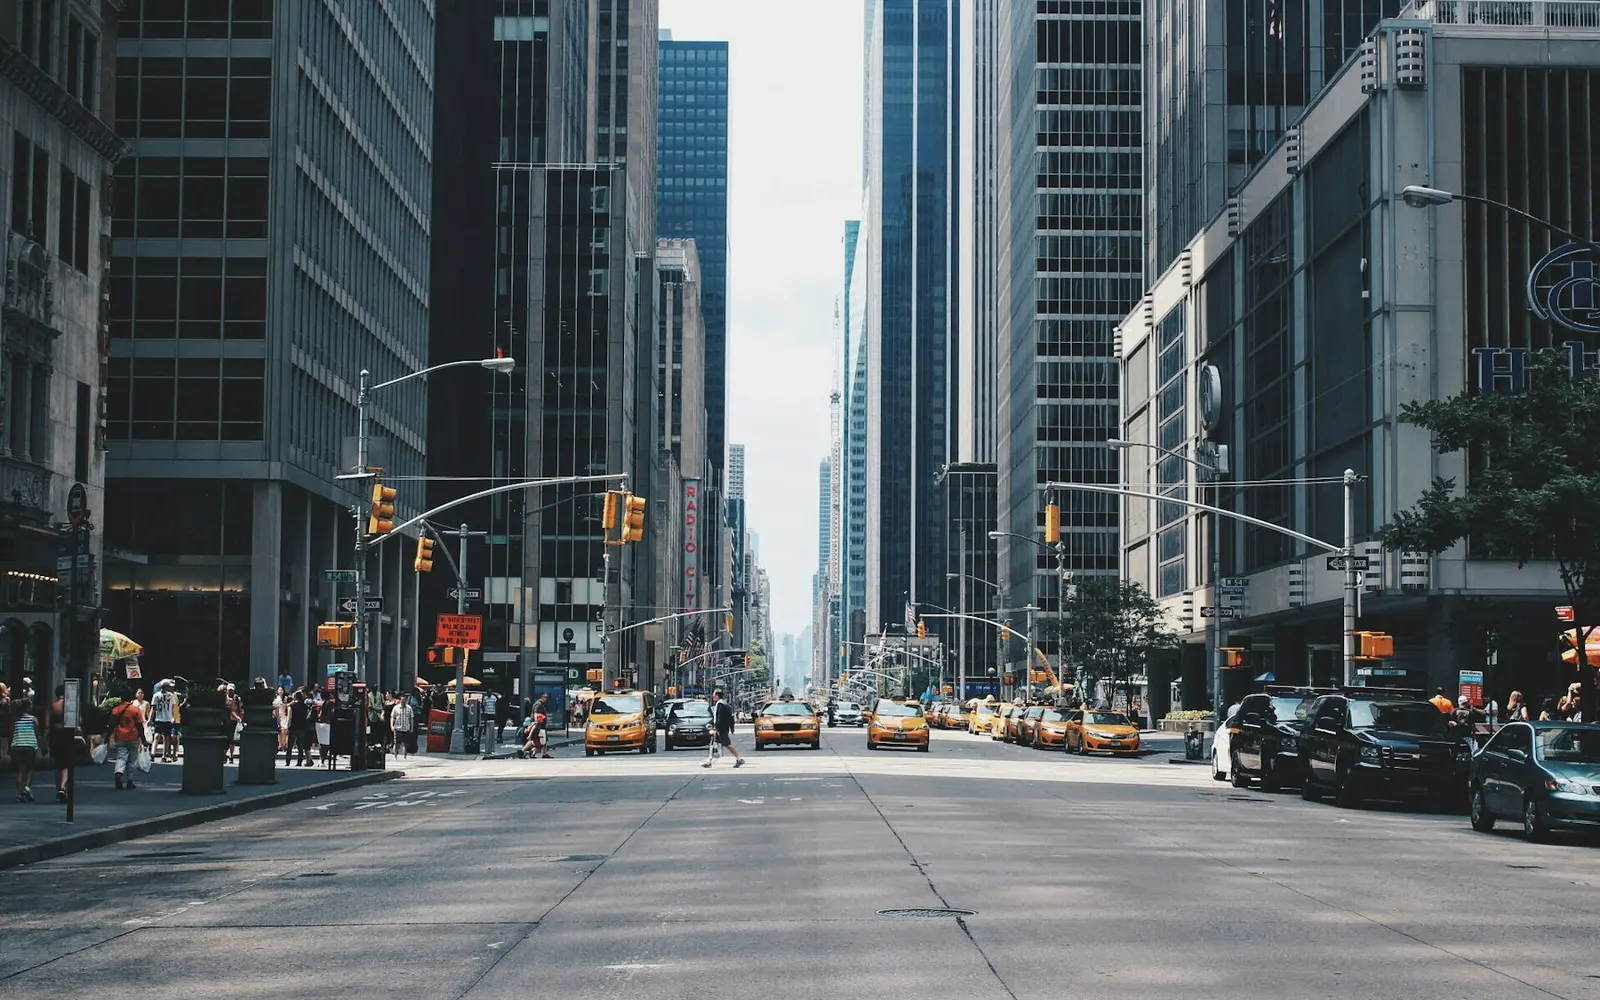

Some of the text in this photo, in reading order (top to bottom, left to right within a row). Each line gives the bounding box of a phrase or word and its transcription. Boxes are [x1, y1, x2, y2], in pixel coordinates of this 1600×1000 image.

[333, 572, 342, 581] 54
[685, 486, 697, 620] RADIO CITY
